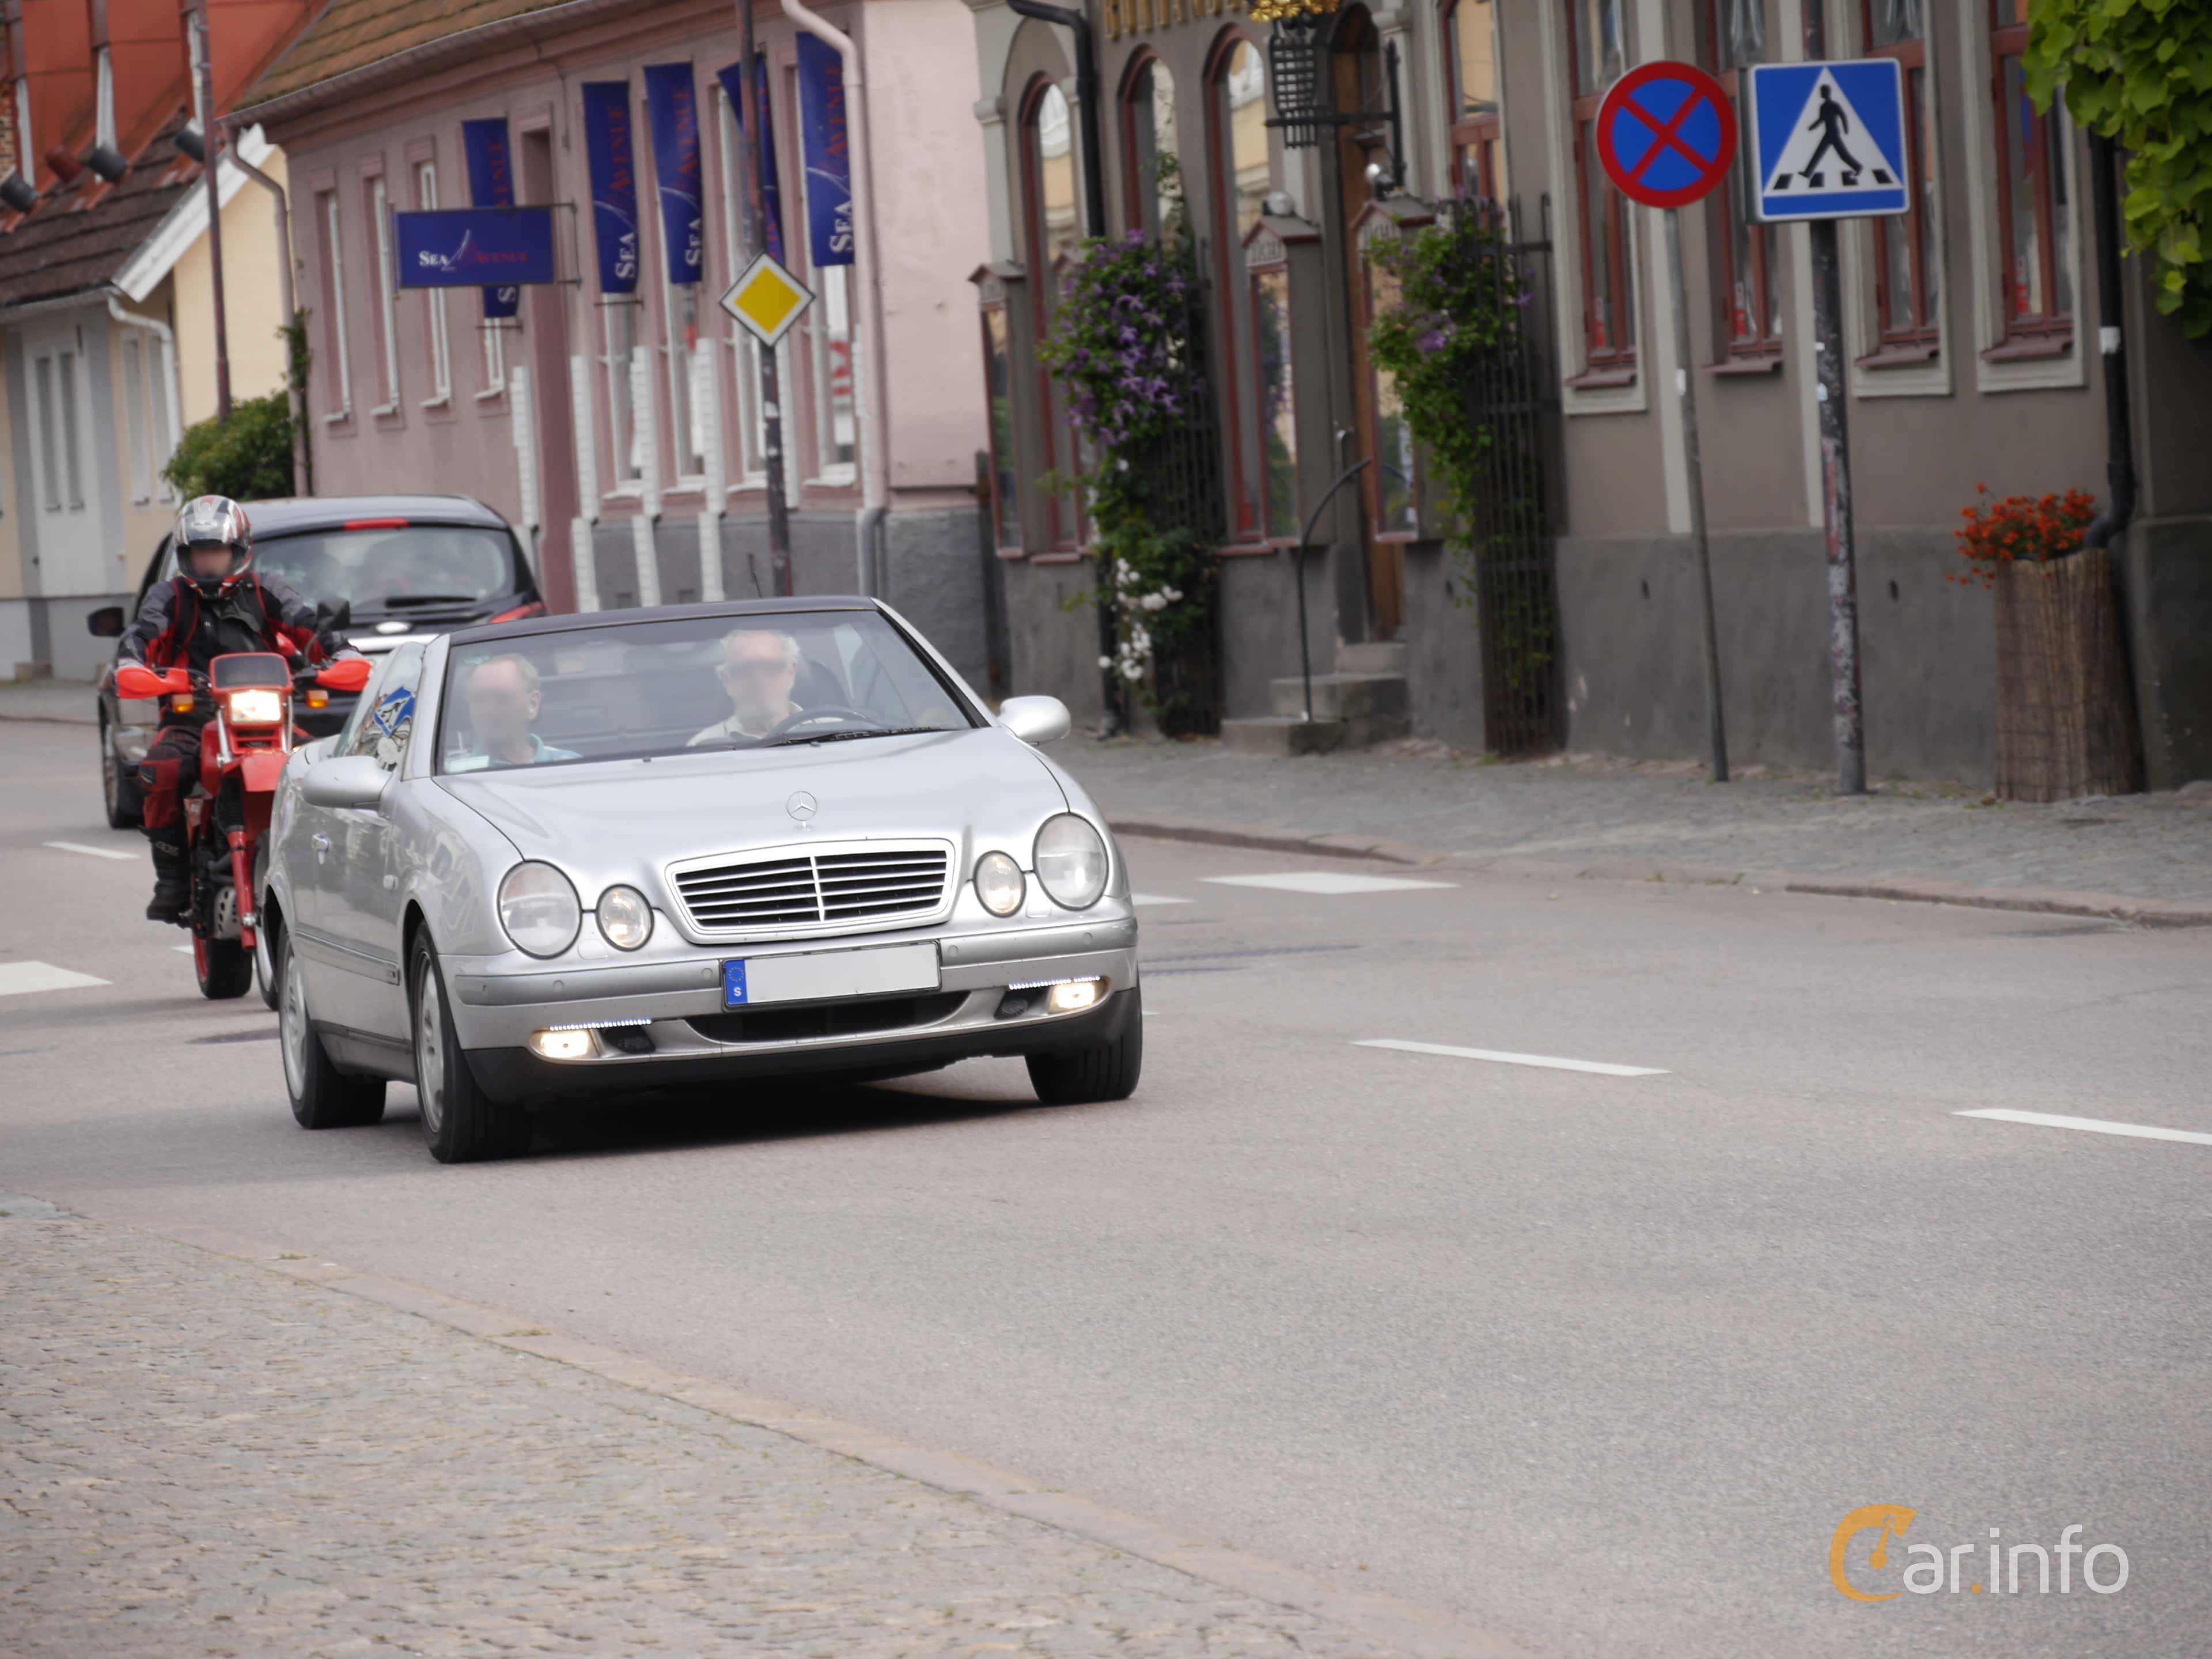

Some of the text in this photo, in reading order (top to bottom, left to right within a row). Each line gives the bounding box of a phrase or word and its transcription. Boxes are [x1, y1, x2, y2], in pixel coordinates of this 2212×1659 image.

[685, 218, 702, 266] SEA
[829, 199, 853, 252] SEA
[615, 232, 635, 279] SEA
[734, 987, 741, 997] S
